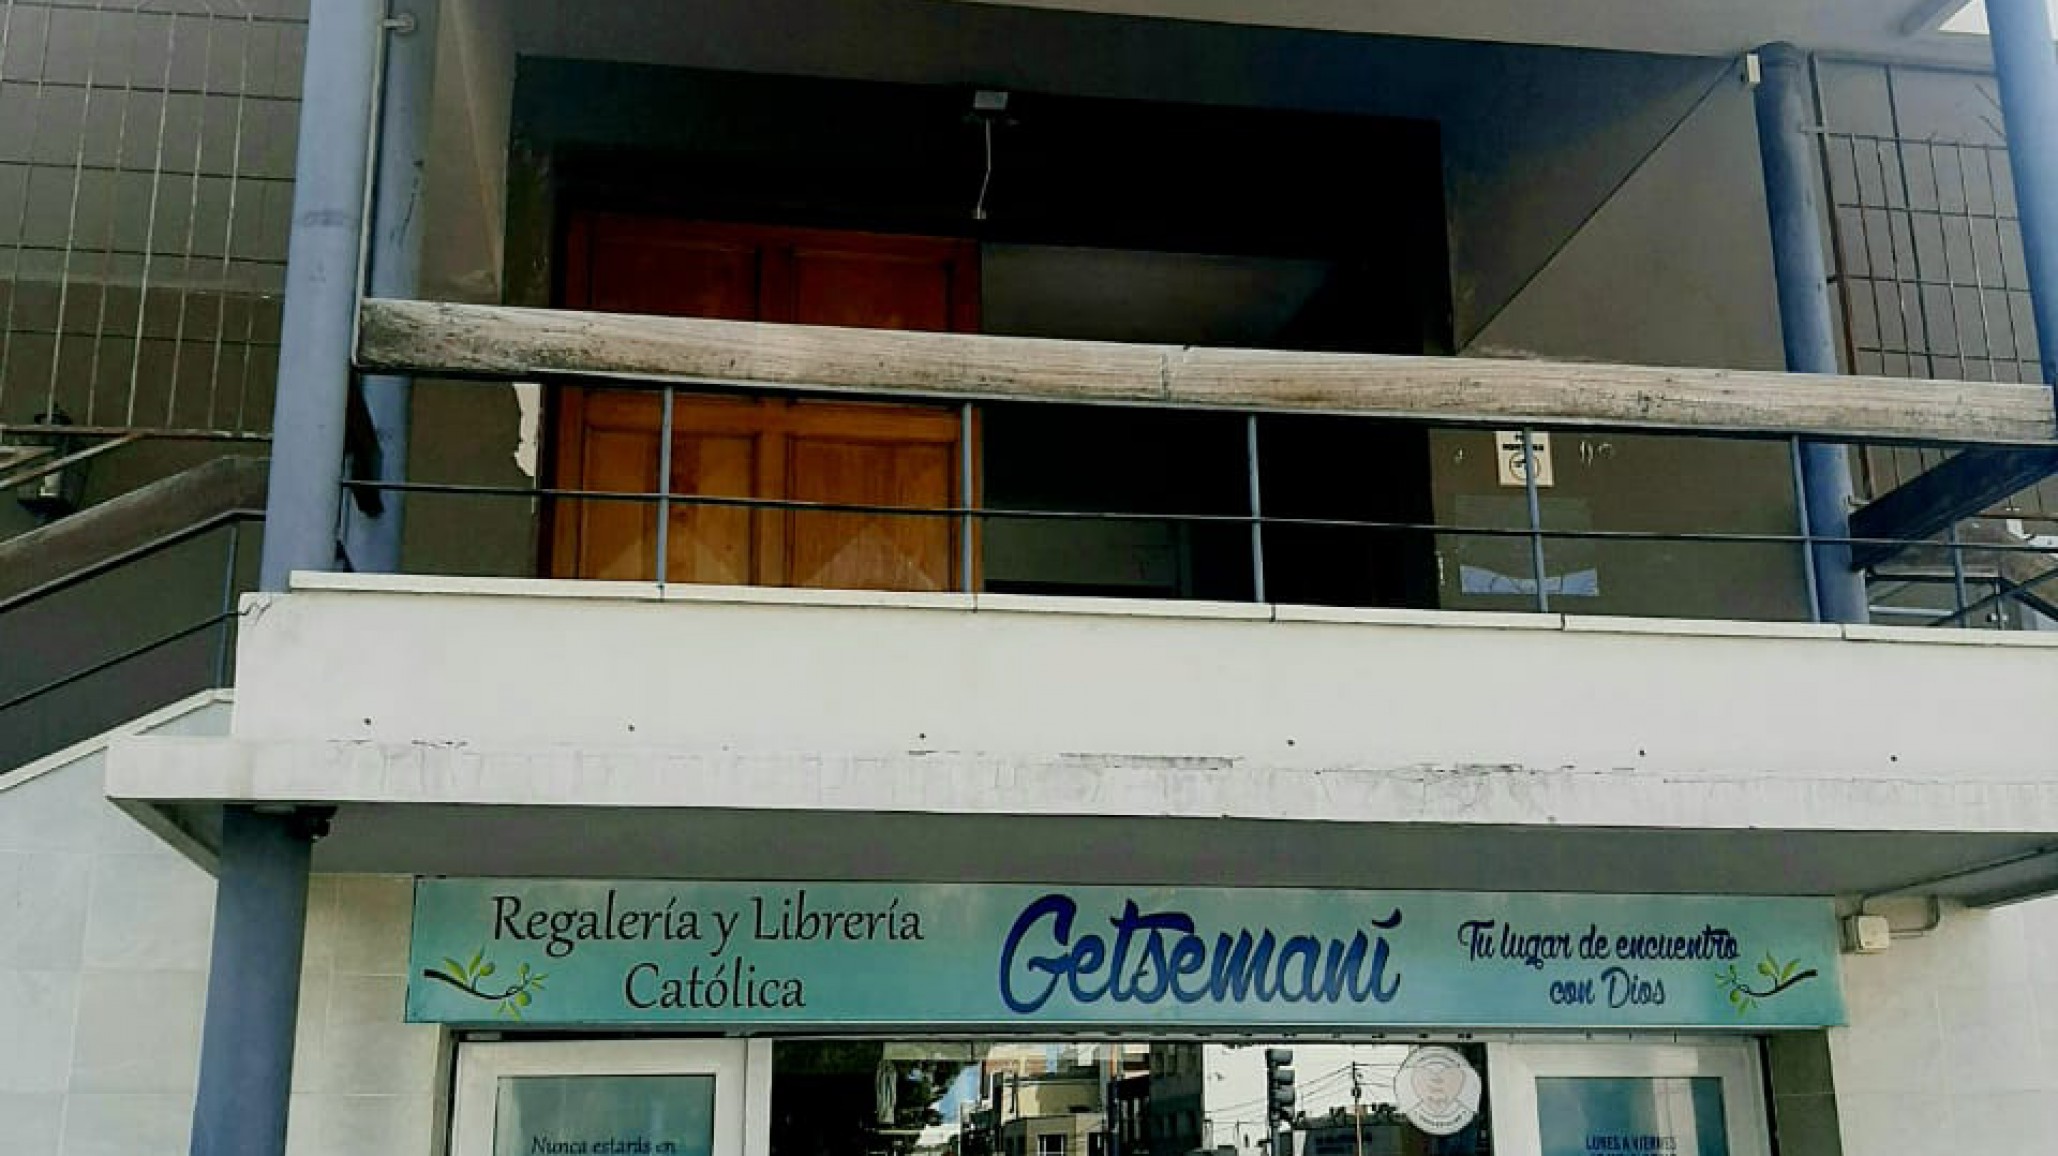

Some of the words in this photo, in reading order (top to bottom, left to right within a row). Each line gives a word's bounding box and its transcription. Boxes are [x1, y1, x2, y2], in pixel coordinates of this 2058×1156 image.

[493, 890, 703, 958] Regalería
[711, 911, 742, 960] y
[751, 890, 924, 941] Librería
[1458, 919, 1496, 961] Tu
[1500, 922, 1573, 970] lugar
[1579, 924, 1610, 961] de
[1615, 923, 1742, 961] encuentro
[1000, 893, 1402, 1014] Getsemaní
[624, 955, 806, 1009] Católica
[1549, 977, 1596, 1006] con
[1600, 966, 1666, 1010] Dios
[531, 1135, 588, 1156] Nunca
